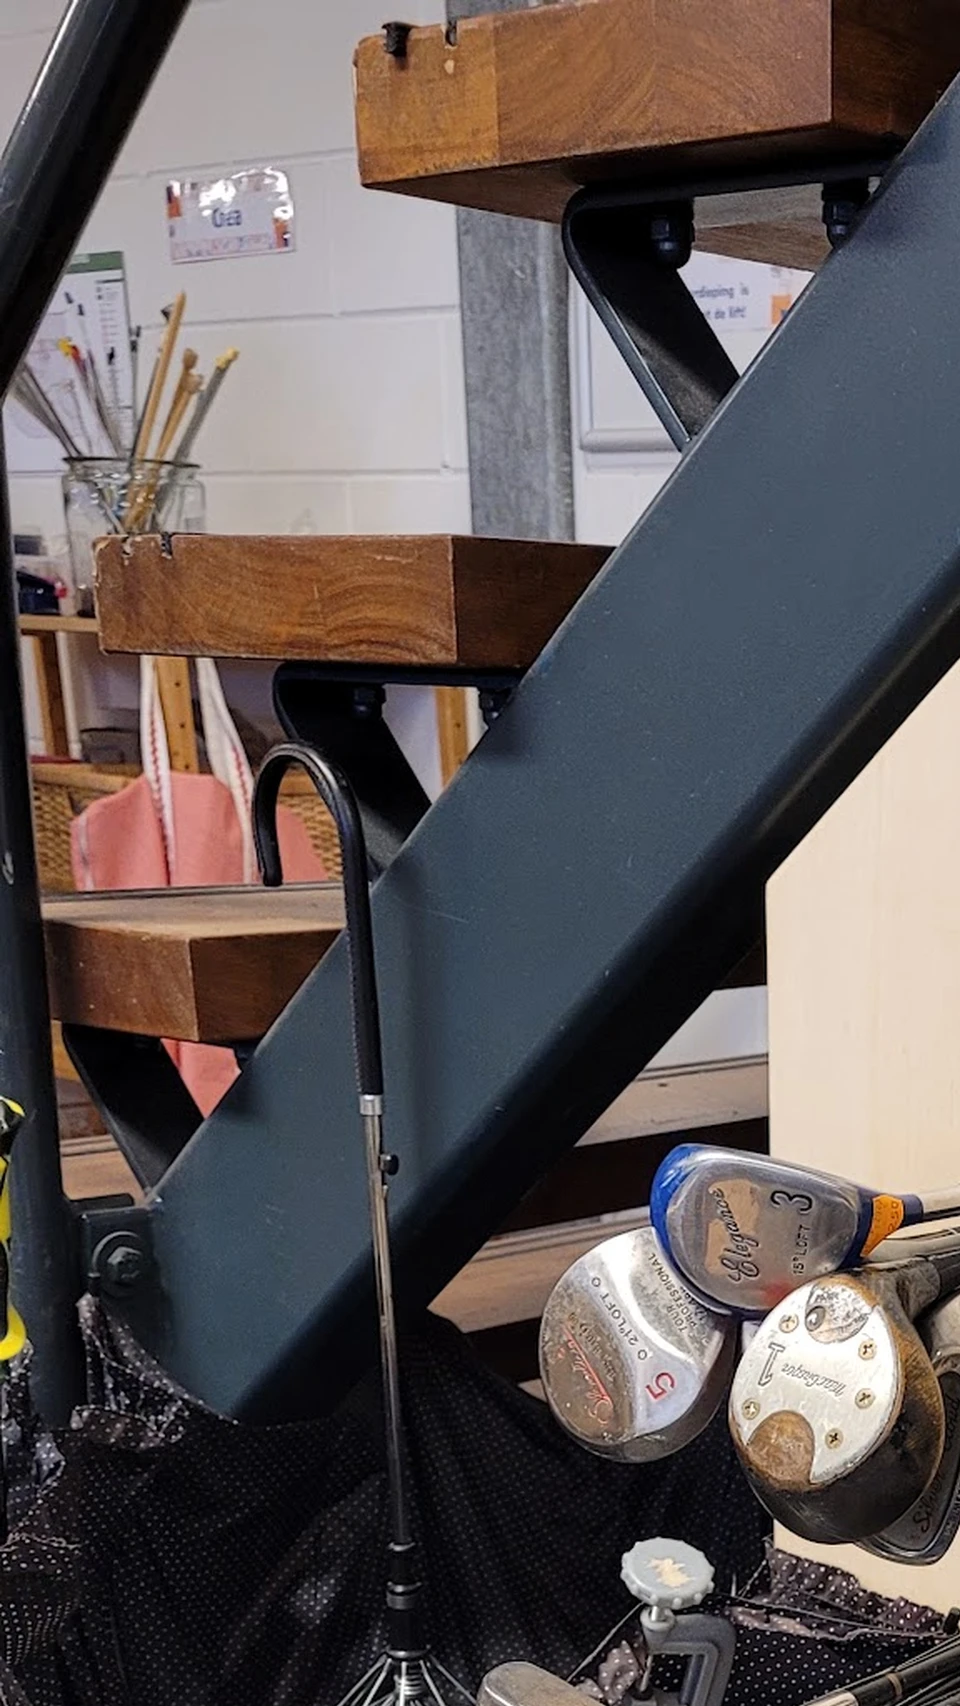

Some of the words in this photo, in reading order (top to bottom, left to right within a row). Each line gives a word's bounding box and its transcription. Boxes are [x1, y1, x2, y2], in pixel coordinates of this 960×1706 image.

[770, 1190, 814, 1214] 3
[650, 1253, 697, 1328] PROFESSIONAL
[666, 1304, 689, 1333] TOUR
[758, 1341, 786, 1387] 1
[645, 1371, 676, 1401] 5
